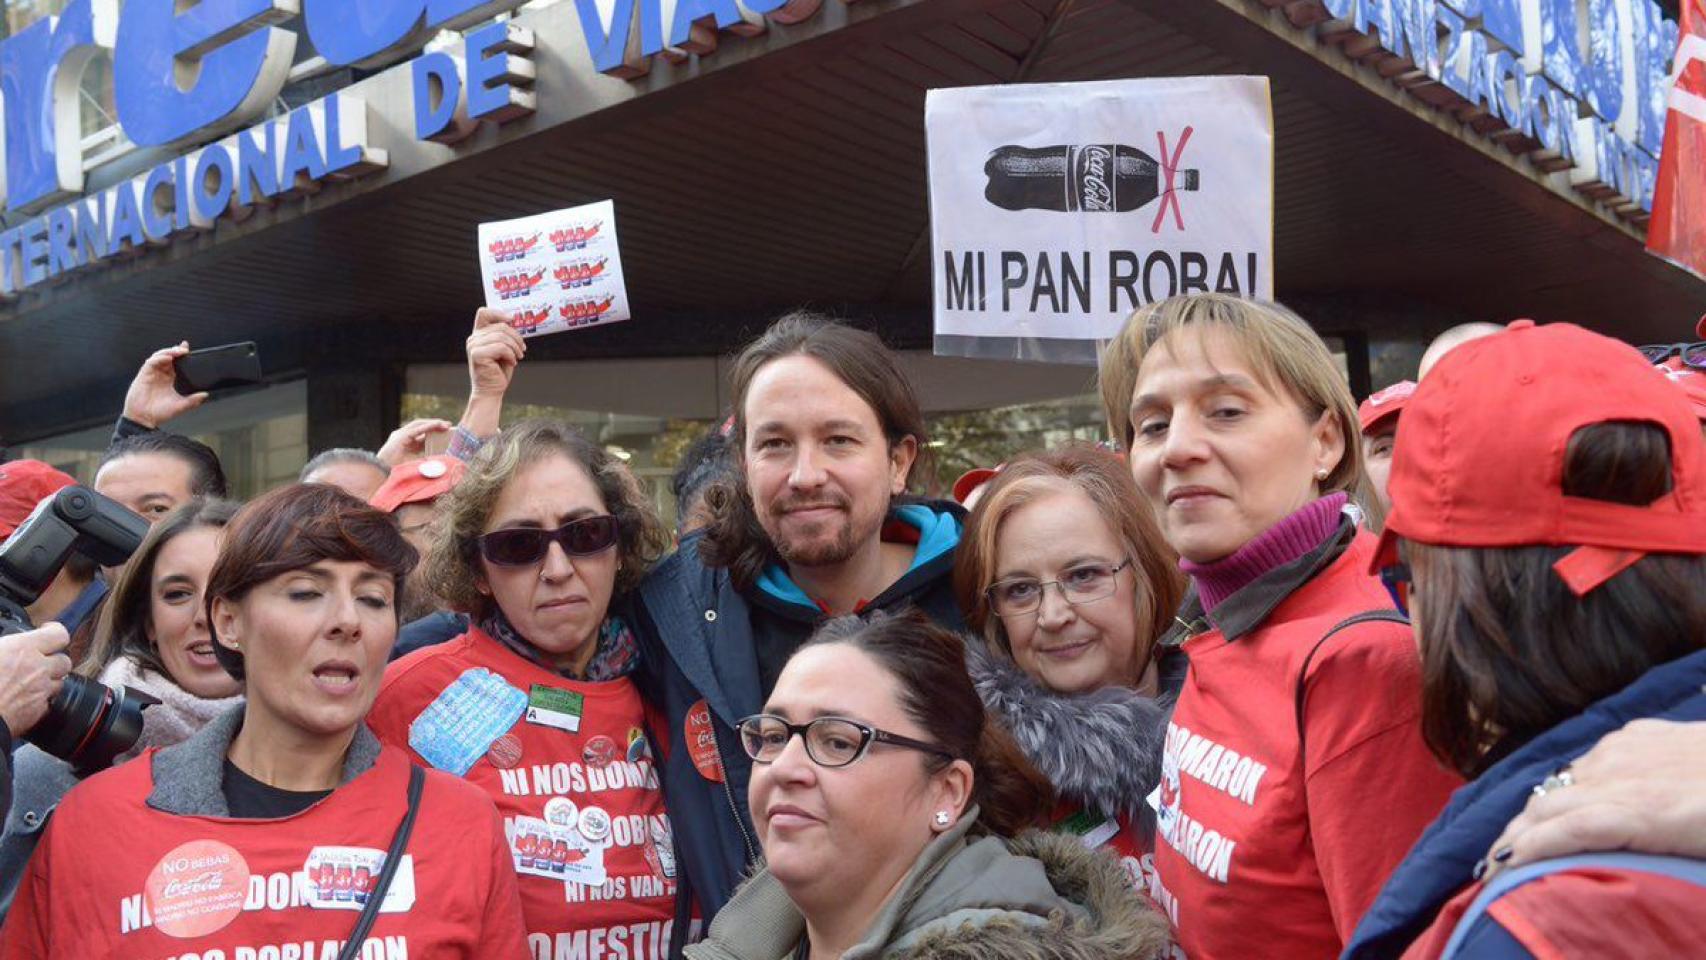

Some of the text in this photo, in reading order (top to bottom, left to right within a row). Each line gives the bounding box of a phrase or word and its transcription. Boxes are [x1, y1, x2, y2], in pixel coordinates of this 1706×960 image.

[412, 20, 522, 140] DE
[944, 250, 986, 311] MI
[1000, 250, 1091, 313] PAN
[499, 768, 530, 796] NI
[532, 762, 587, 795] NOS
[162, 858, 189, 875] NO
[630, 875, 665, 899] VAN
